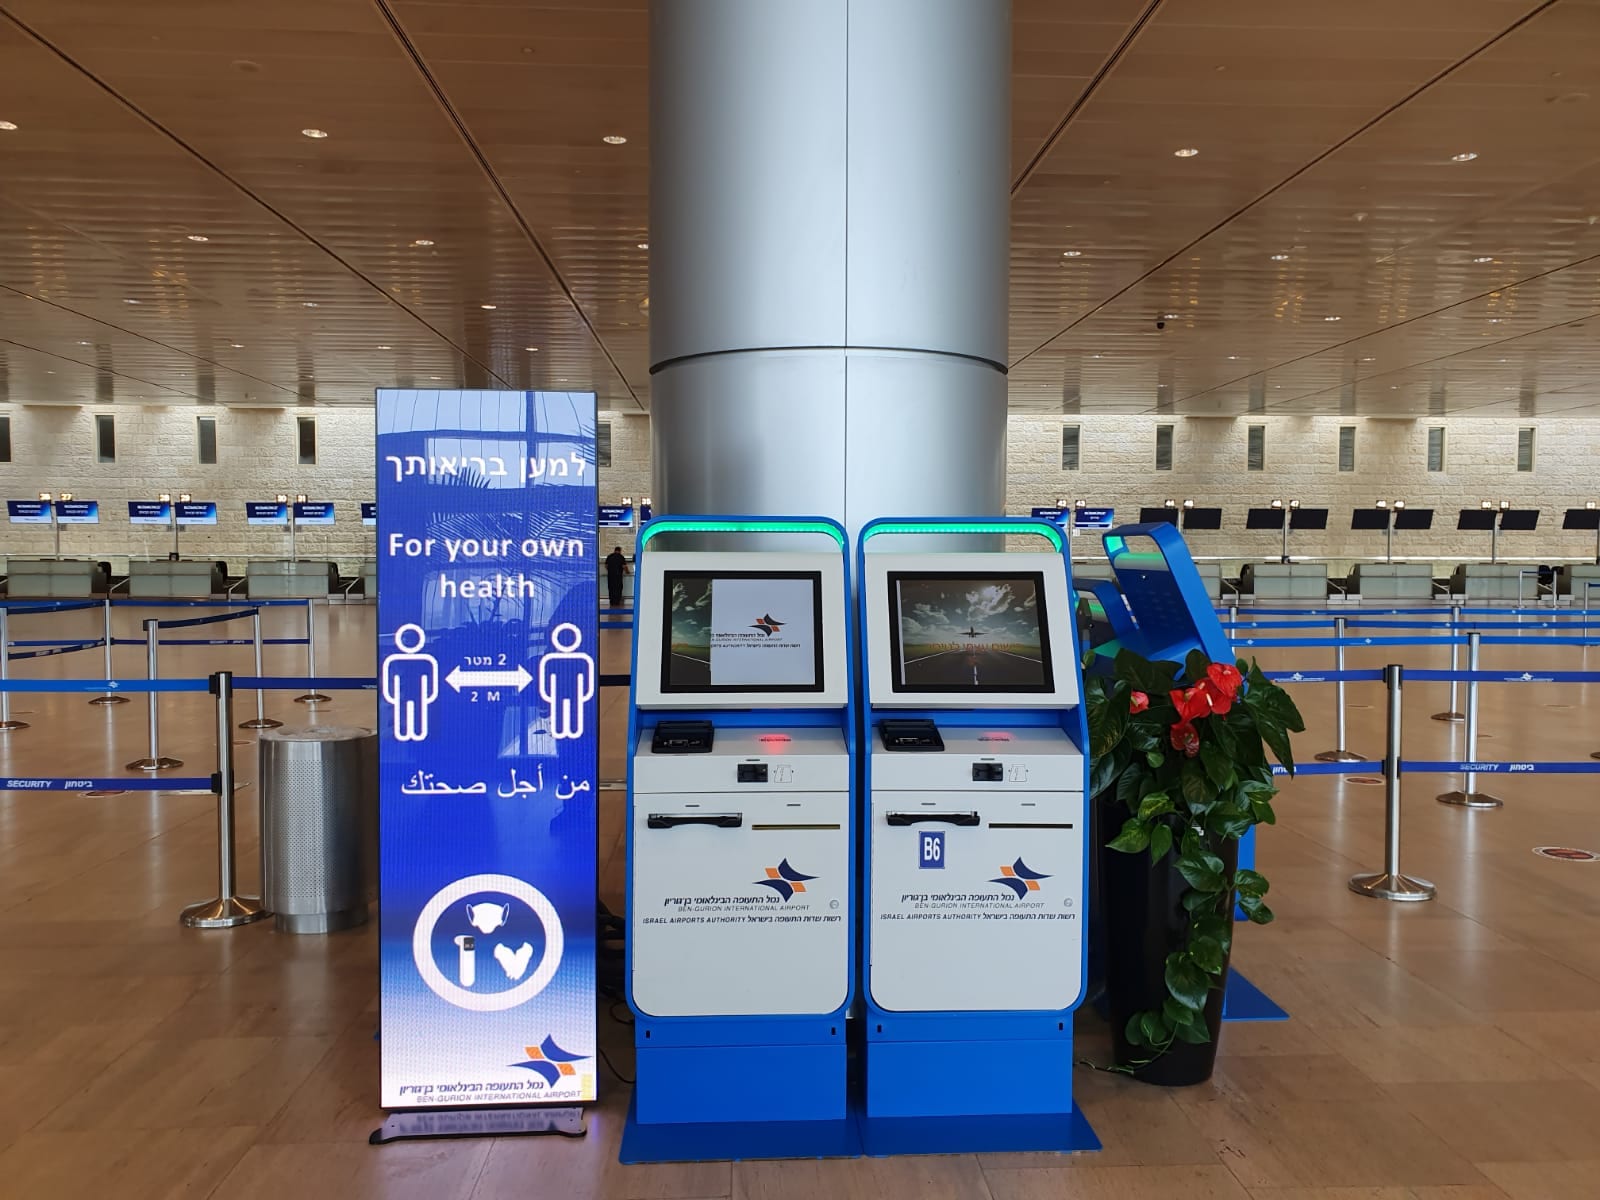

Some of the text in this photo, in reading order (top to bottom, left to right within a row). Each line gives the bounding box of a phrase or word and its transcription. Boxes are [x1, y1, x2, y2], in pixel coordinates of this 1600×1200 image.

[385, 452, 586, 483] למען בריאותך
[389, 533, 584, 562] For your own
[440, 573, 535, 598] health
[463, 654, 507, 666] 2 מטר
[471, 691, 501, 702] 2 M
[1460, 763, 1499, 771] SECURITY
[7, 779, 52, 788] SECURITY
[401, 762, 591, 799] من أجل صحتك
[924, 837, 941, 861] B6
[474, 1092, 542, 1101] INTERNATIONAL
[544, 1090, 583, 1099] AIRPORT
